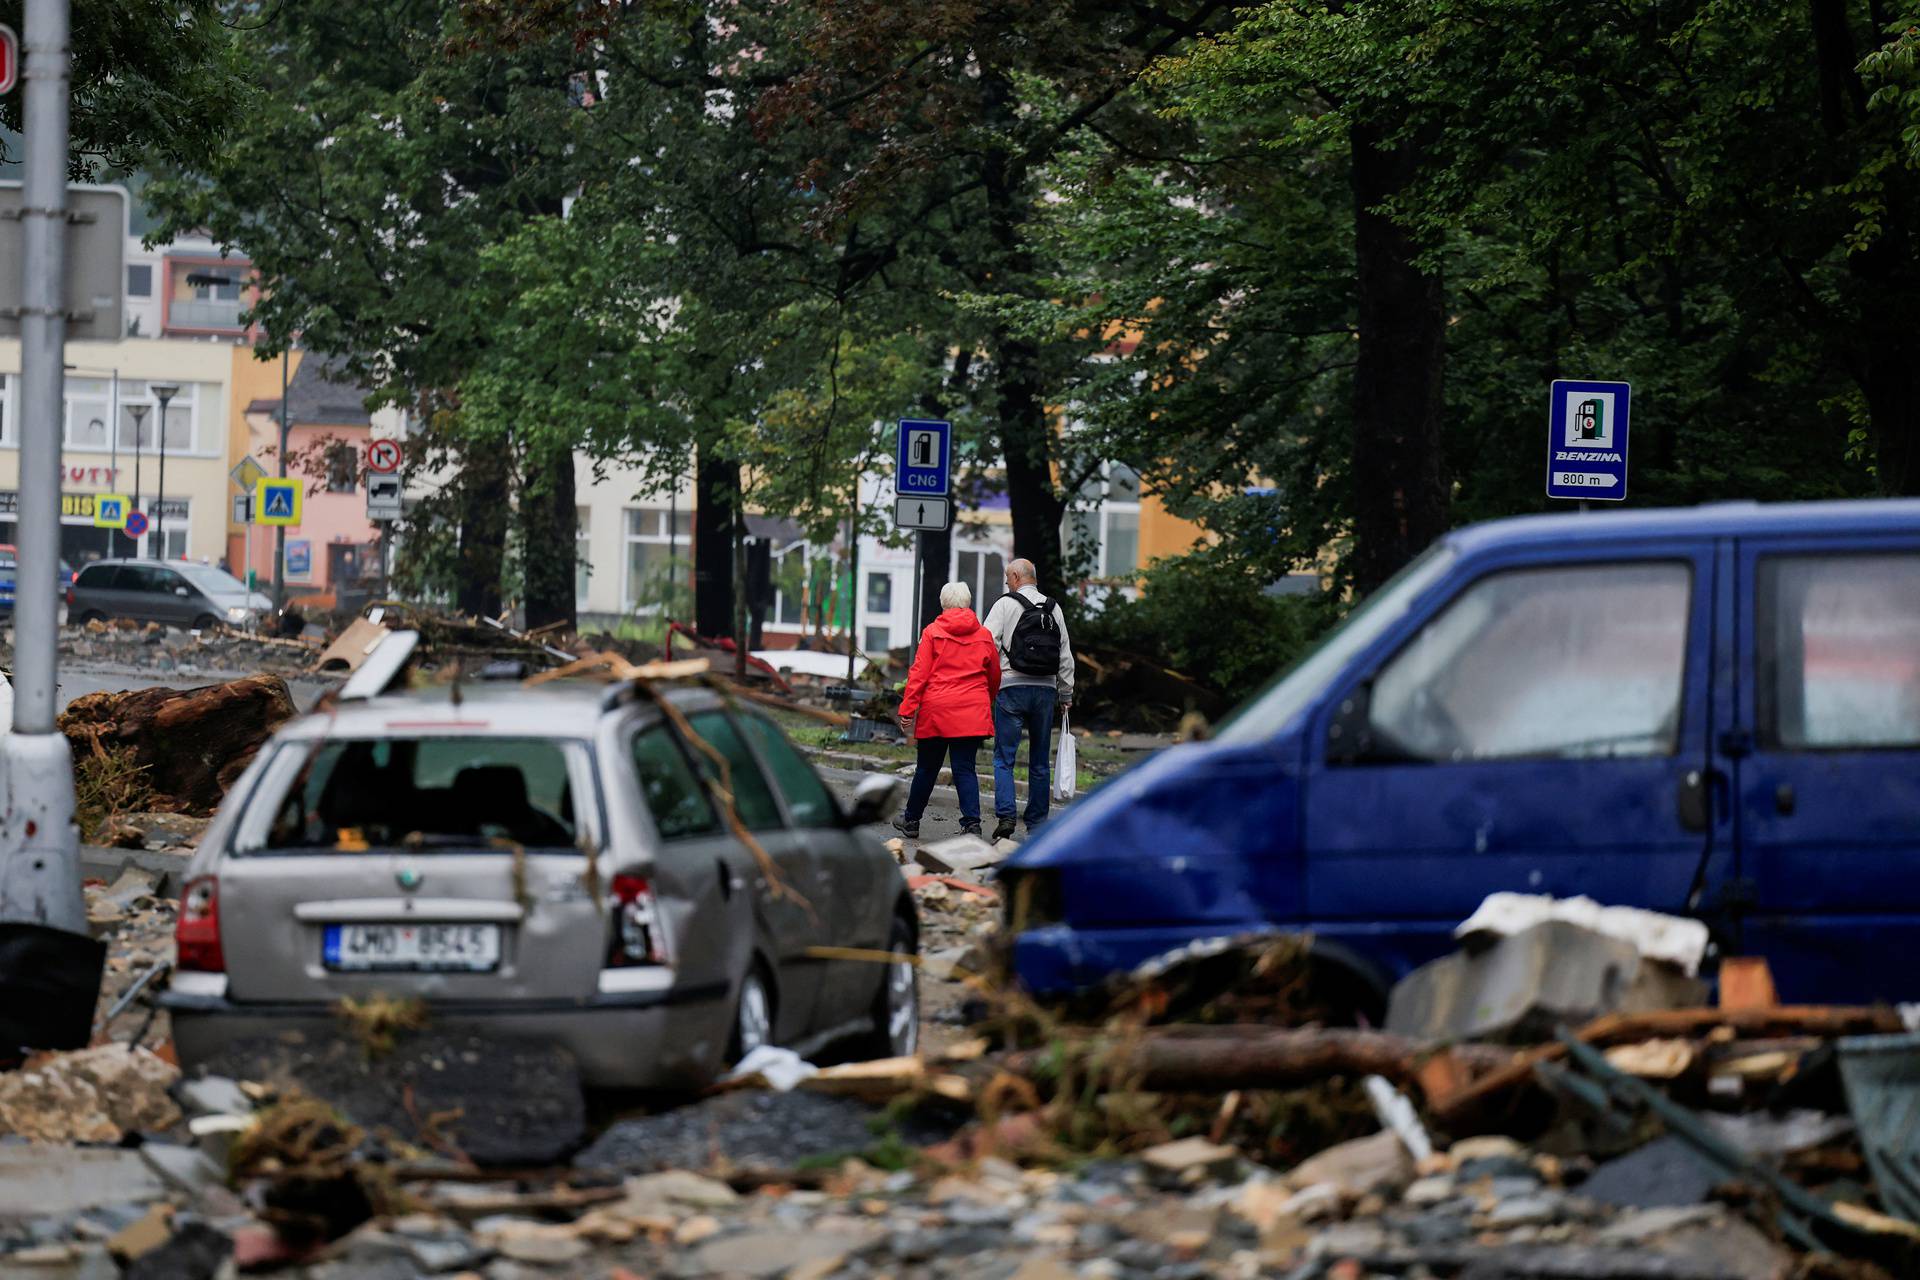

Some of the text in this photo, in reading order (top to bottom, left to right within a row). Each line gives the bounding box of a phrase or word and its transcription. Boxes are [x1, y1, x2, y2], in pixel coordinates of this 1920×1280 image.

[1555, 451, 1622, 462] BENZINA
[908, 474, 937, 487] CNG
[1563, 473, 1600, 485] 800 m
